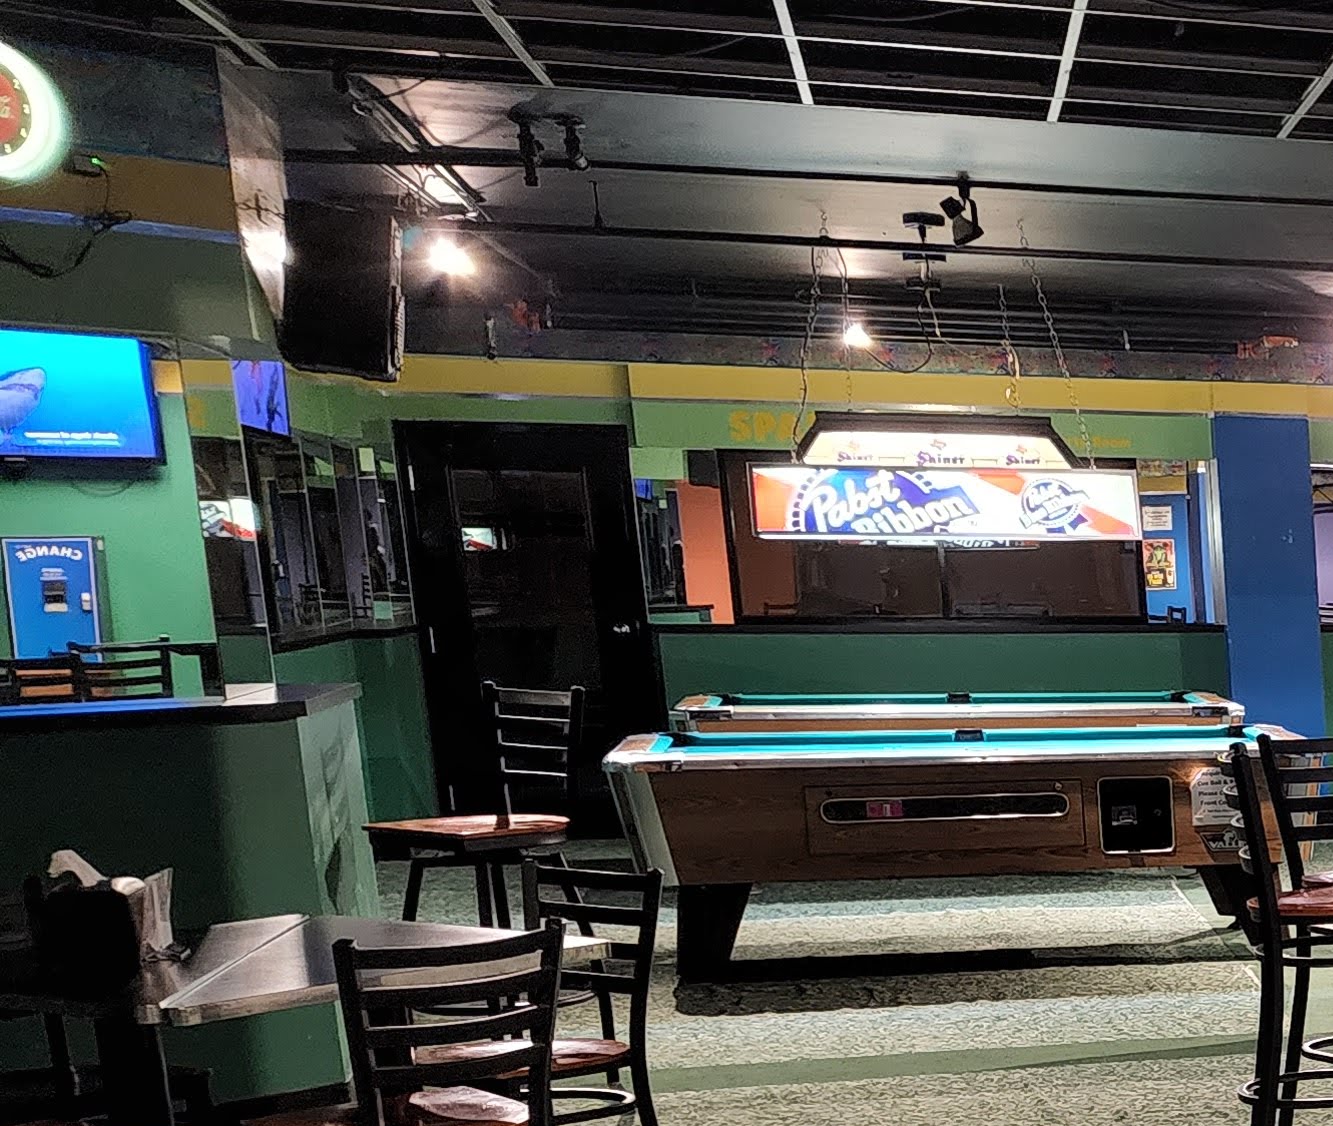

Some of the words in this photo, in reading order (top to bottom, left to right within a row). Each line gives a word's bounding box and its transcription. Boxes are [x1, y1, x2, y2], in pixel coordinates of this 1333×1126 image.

[916, 451, 965, 468] Shiner
[802, 469, 901, 533] Pabst
[1208, 841, 1247, 849] VALLE
